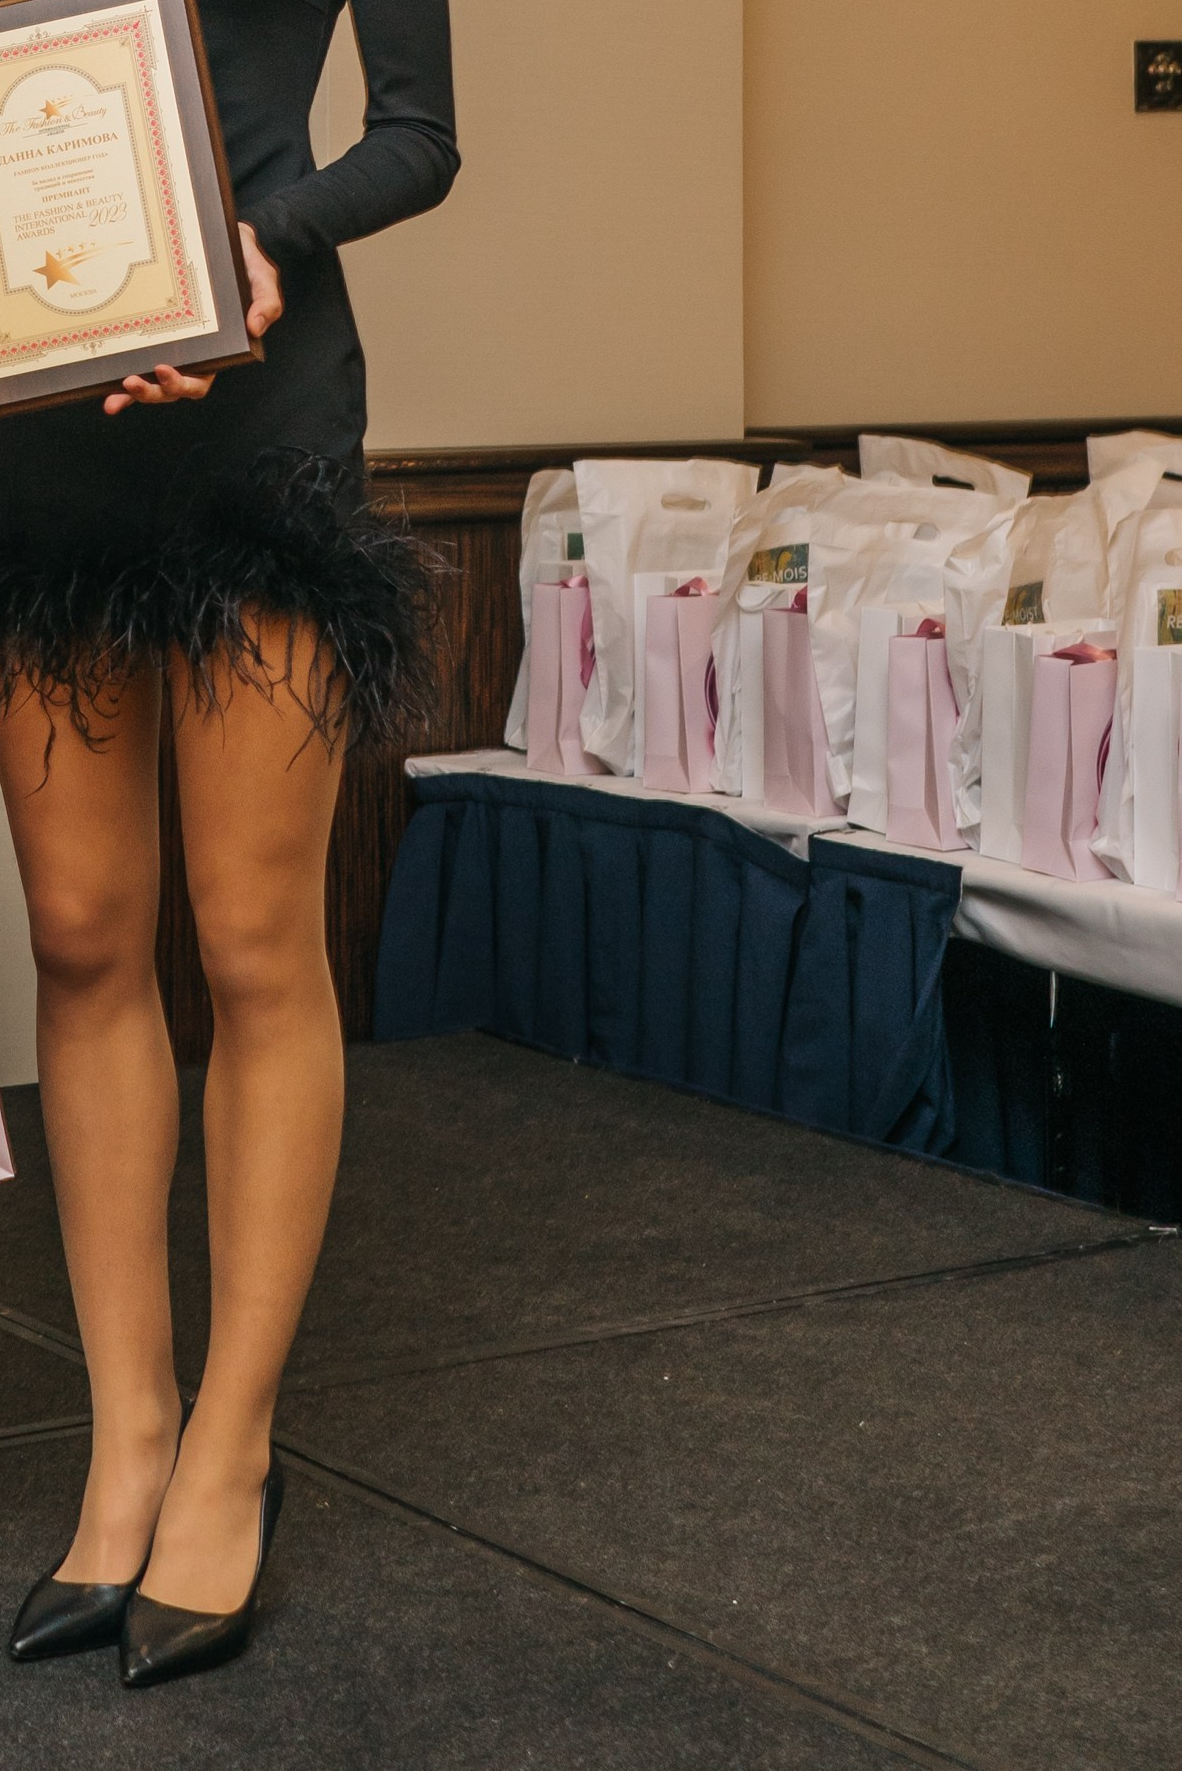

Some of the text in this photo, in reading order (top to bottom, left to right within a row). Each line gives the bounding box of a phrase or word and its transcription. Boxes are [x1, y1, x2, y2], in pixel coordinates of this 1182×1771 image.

[0, 120, 20, 136] The
[23, 116, 64, 131] Fashion
[72, 105, 107, 120] Beauty
[46, 132, 119, 155] КАРИМОВА
[13, 193, 124, 224] THE FASHION & BEAUTY
[14, 202, 128, 233] INTERNATIONAL 2023
[16, 226, 56, 242] AWARDS
